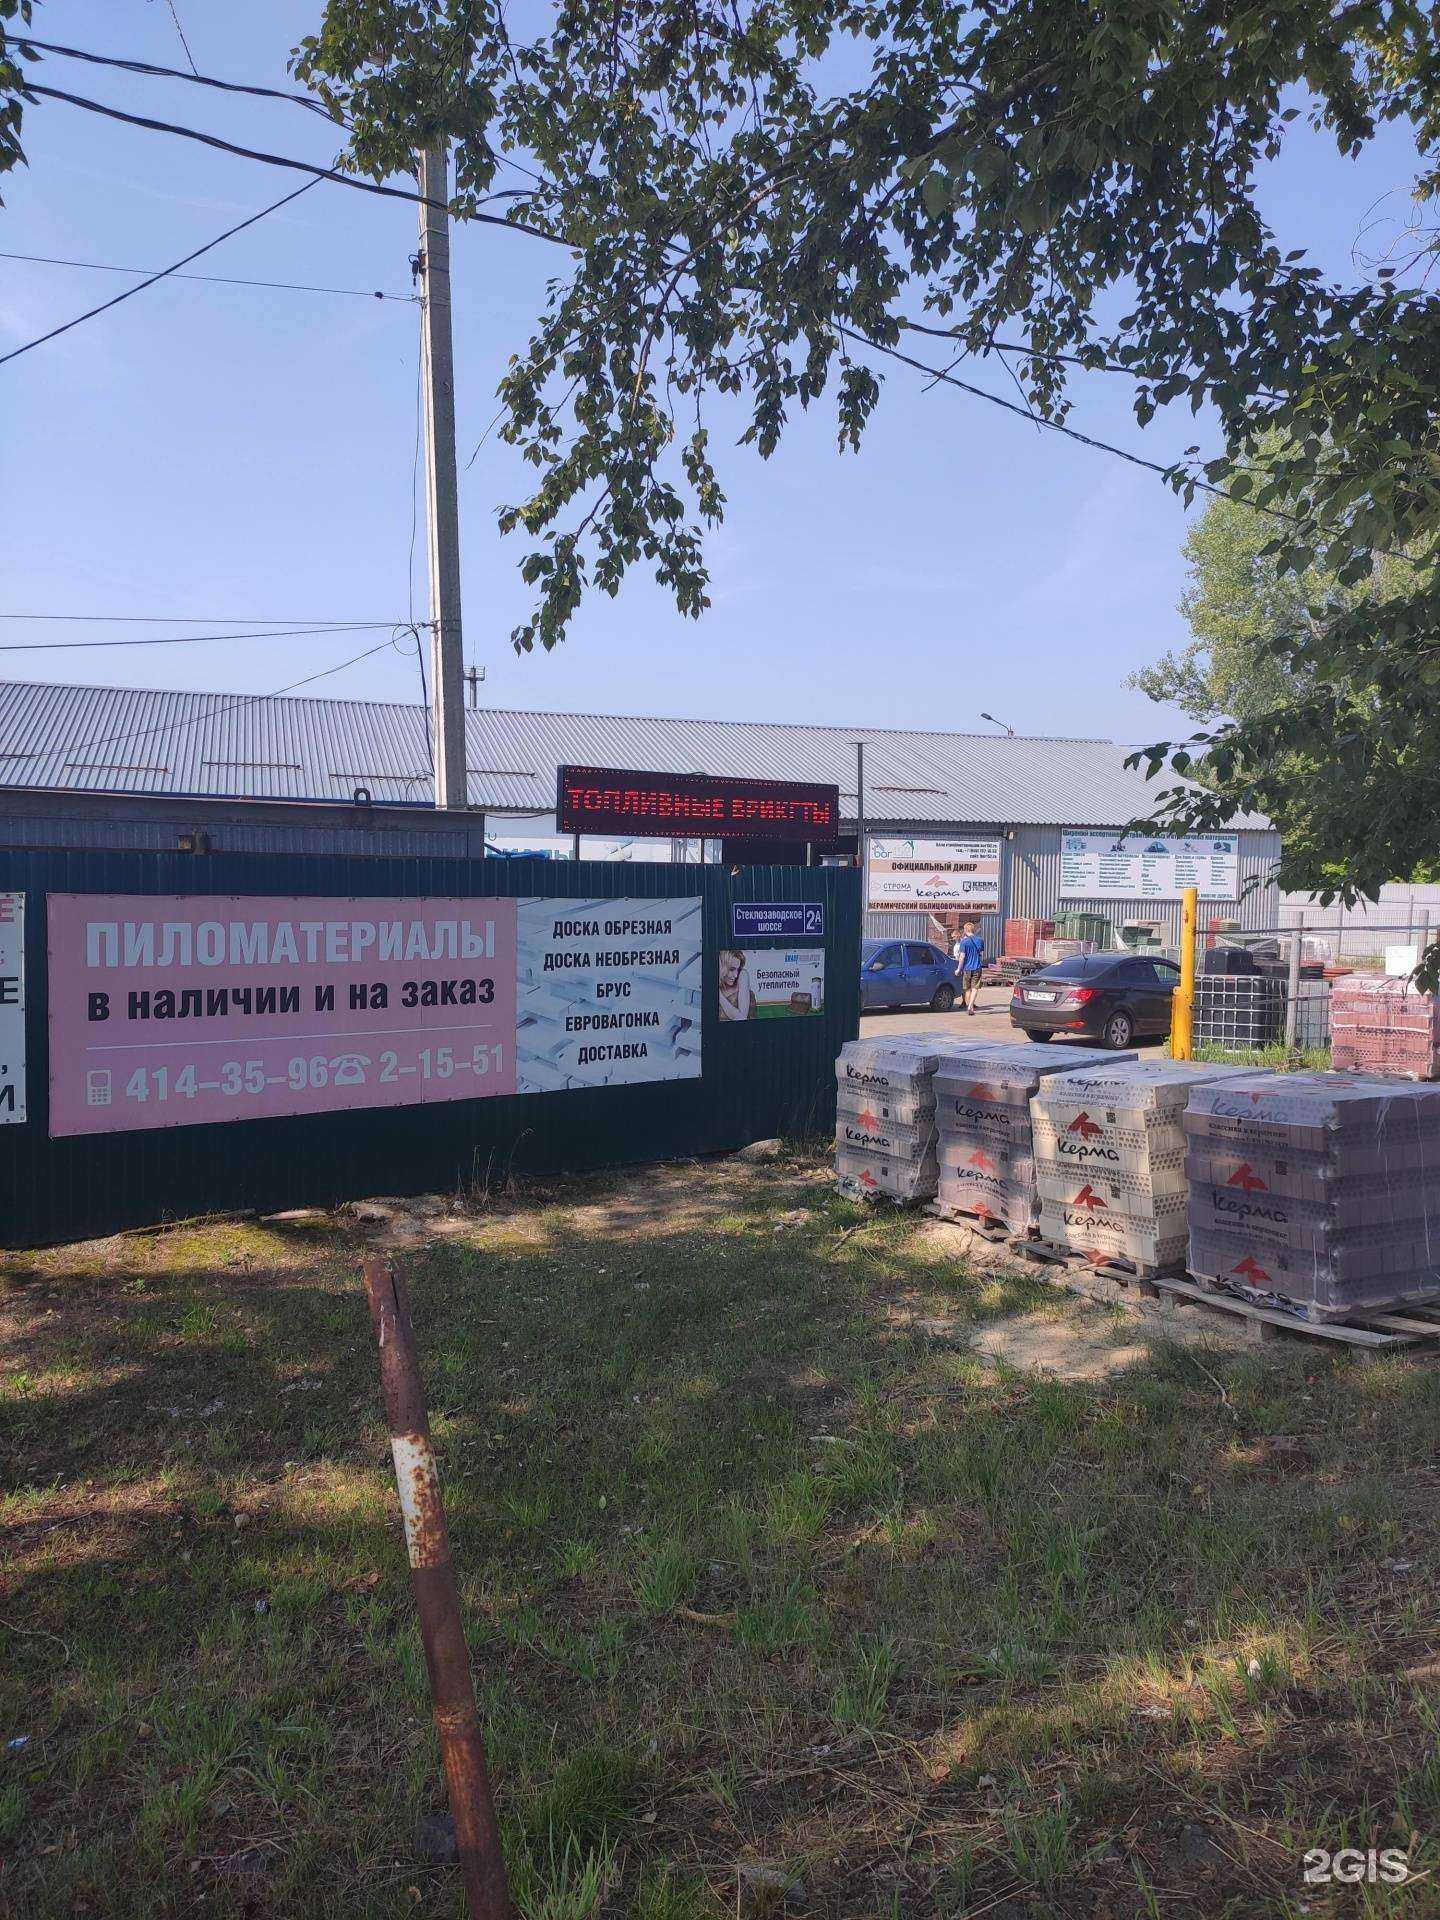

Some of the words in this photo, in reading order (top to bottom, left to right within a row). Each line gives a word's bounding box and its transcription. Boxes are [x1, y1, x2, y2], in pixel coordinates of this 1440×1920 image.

[891, 861, 952, 871] ОФИЦИАЛЬНЫЙ
[953, 863, 978, 872] ДИЛЕР
[736, 908, 803, 921] Стеклозаводское
[552, 920, 600, 939] ДОСКА
[604, 919, 672, 936] ОБРЕЗНАЯ
[757, 922, 783, 932] шоссе
[86, 920, 497, 968] ПИЛОМАТЕРИАЛЫ
[543, 951, 591, 971] ДОСКА
[595, 949, 680, 968] НЕОБРЕЗНАЯ
[756, 968, 800, 980] Безопасный
[596, 981, 631, 999] БРУС
[758, 980, 800, 992] утеплитель
[88, 992, 110, 1021] в
[128, 984, 301, 1020] наличии
[314, 984, 335, 1011] и
[350, 982, 389, 1010] на
[401, 977, 496, 1007] заказ
[565, 1011, 660, 1032] ЕВРОВАГОНКА
[378, 1044, 505, 1083] 2-15-51
[577, 1042, 648, 1065] ДОСТАВКА
